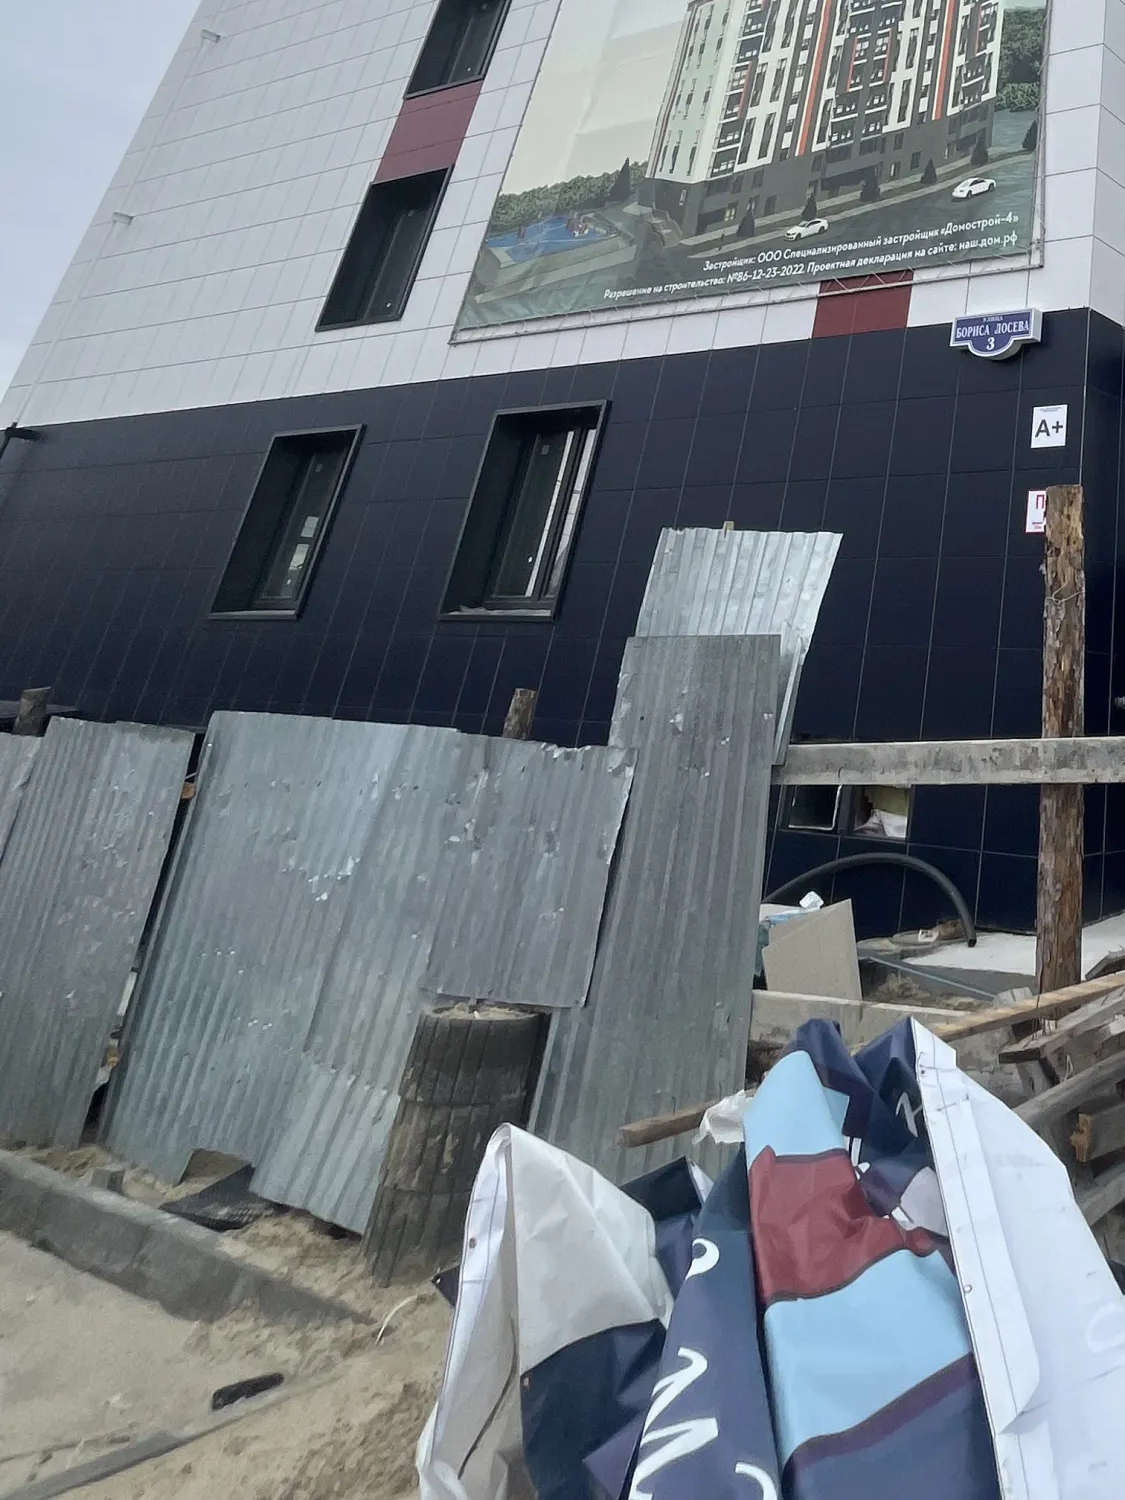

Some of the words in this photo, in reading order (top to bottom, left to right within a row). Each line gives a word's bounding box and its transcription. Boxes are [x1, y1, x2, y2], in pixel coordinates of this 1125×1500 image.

[702, 255, 756, 272] Застройщик:
[757, 249, 783, 264] ООО
[783, 235, 882, 260] Специализированный
[883, 227, 940, 246] застройщик
[940, 211, 1019, 235] «Домострой-4»
[603, 283, 652, 300] Разрешение
[652, 284, 663, 293] на
[663, 275, 726, 293] строительство:
[806, 257, 856, 274] Проектная
[856, 248, 913, 268] декларация
[914, 248, 926, 258] на
[927, 240, 958, 257] сайте:
[959, 229, 1019, 250] наш.дом.рф
[956, 325, 990, 338] БОРИСА
[994, 320, 1029, 335] ЛОСЕВА
[986, 336, 995, 350] 3
